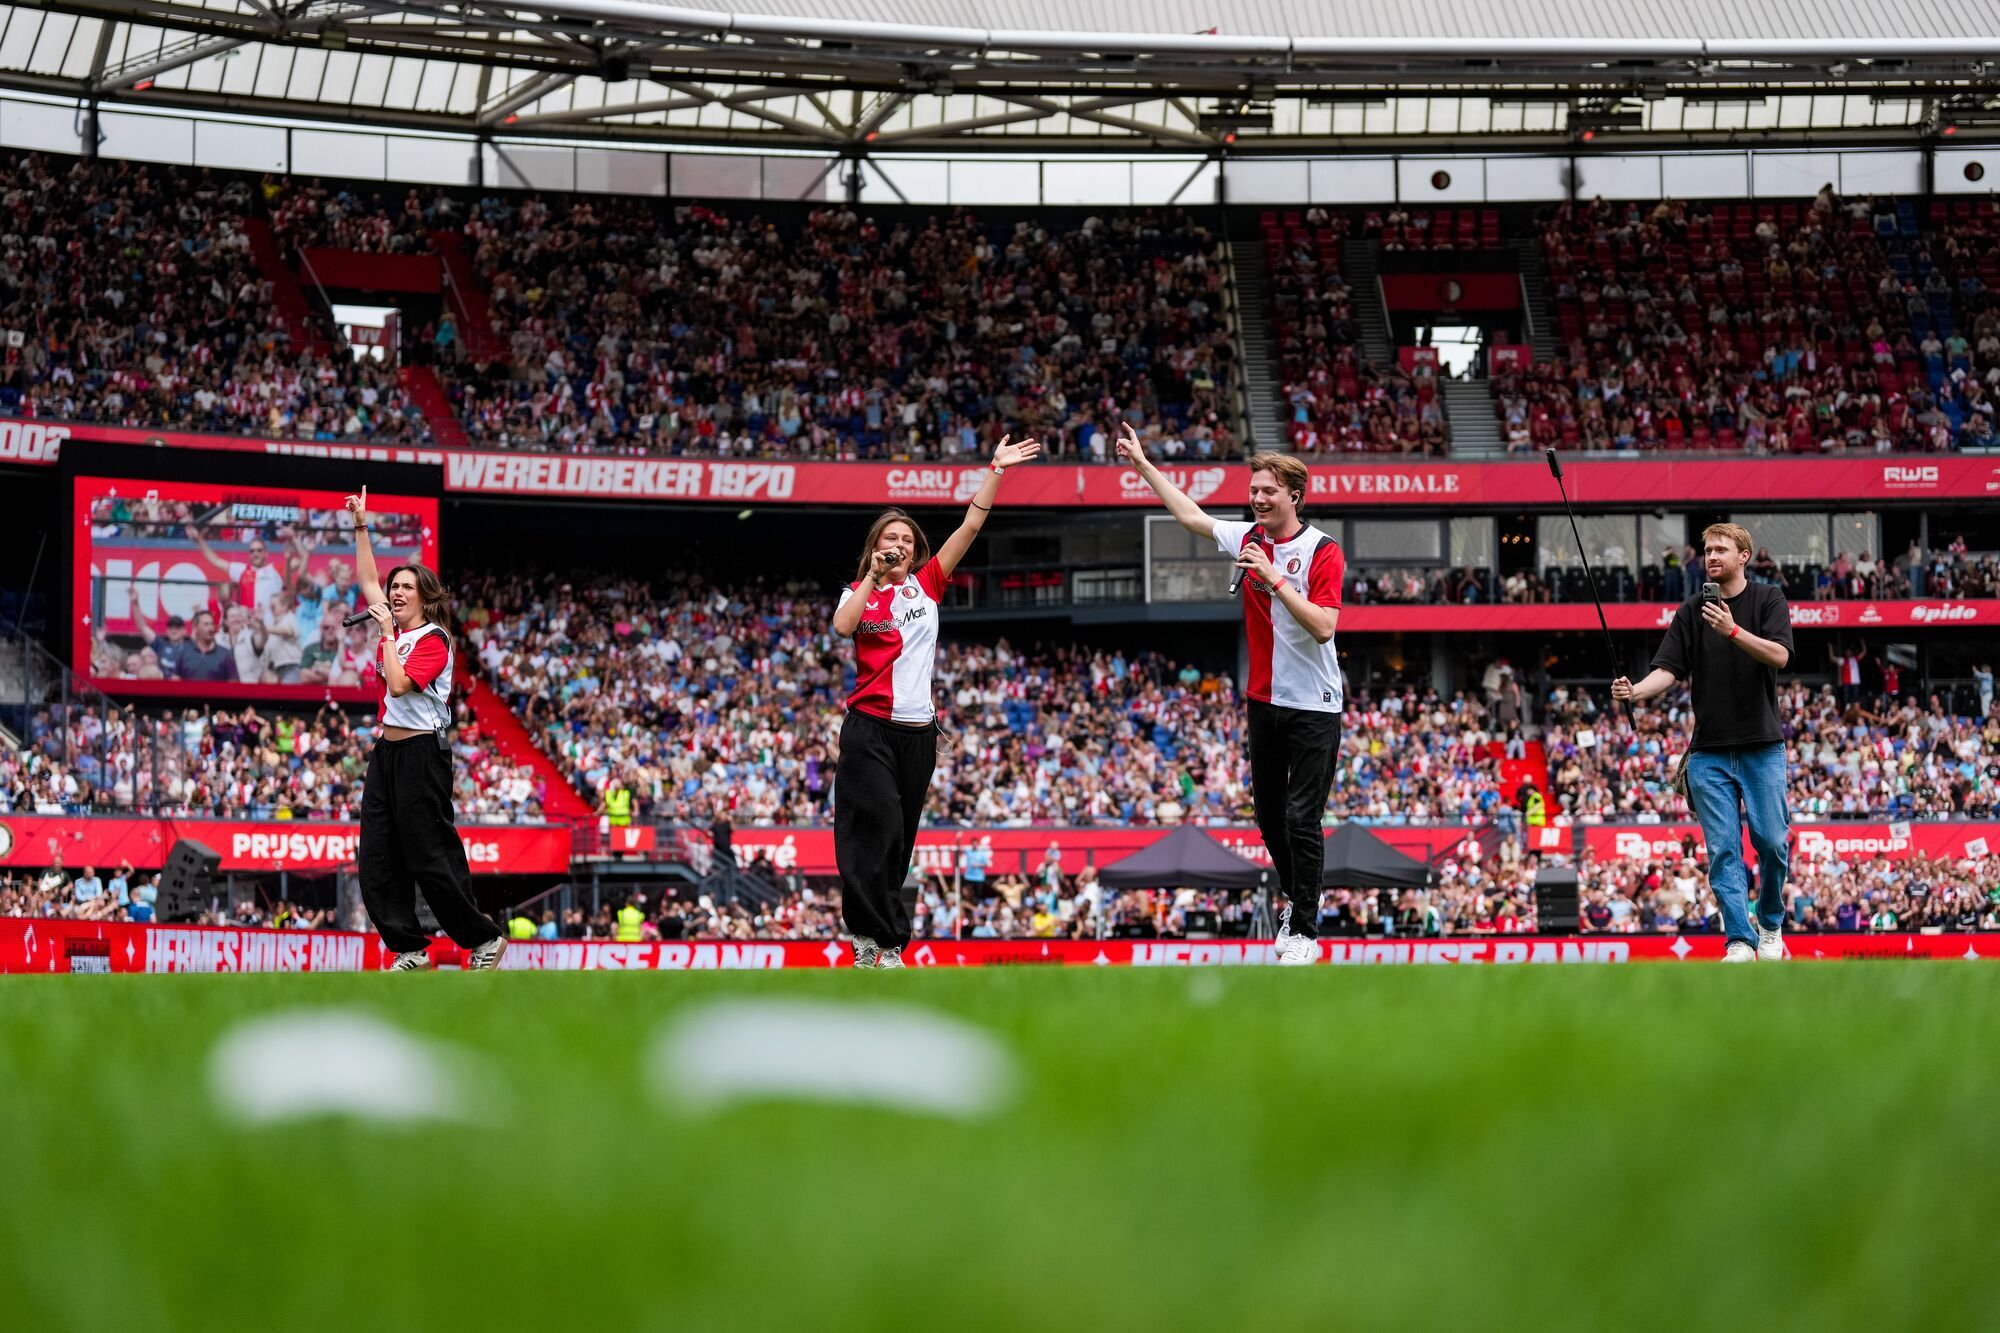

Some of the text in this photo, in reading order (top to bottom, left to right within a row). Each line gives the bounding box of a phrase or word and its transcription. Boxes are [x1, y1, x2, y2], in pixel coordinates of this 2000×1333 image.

[448, 452, 702, 496] WERELDBEKER
[708, 463, 795, 498] 1970
[886, 469, 953, 489] CARU
[1119, 470, 1186, 490] CAU
[1311, 474, 1460, 493] RIVERDALE
[624, 828, 641, 849] V
[1539, 827, 1560, 847] M
[1835, 838, 1908, 853] GROUP
[146, 928, 239, 973] HERMES
[240, 931, 308, 973] HOUSE
[310, 934, 364, 972] BAND
[656, 944, 786, 970] BAND
[1331, 943, 1488, 965] HOUSE
[1493, 942, 1630, 964] BAND
